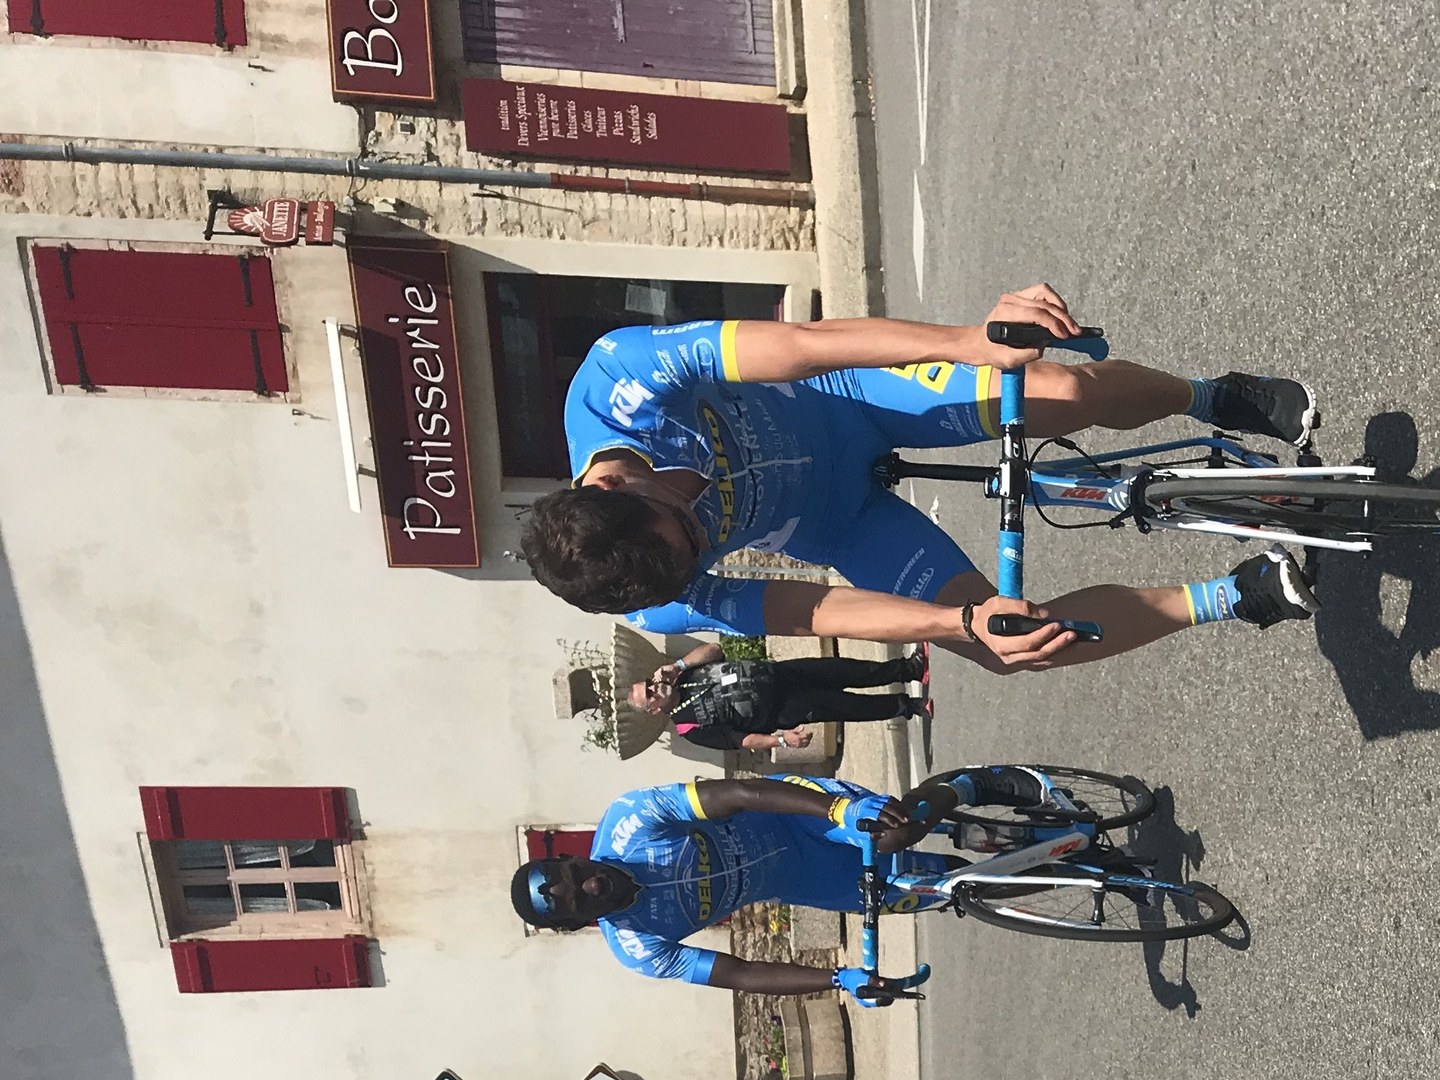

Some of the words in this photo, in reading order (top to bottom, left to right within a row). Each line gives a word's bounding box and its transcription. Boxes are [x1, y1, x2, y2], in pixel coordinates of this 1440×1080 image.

[498, 100, 510, 130] tradition
[535, 92, 549, 141] Viennoiseries
[552, 123, 564, 138] pure
[580, 110, 593, 132] Glaces
[596, 106, 608, 138] Traiteur
[612, 110, 624, 136] Pizzas
[627, 104, 642, 145] Sandwichs
[645, 112, 658, 140] Salades
[517, 121, 530, 146] Divers
[272, 202, 290, 237] JANETTE
[388, 282, 462, 540] Patisserie
[702, 407, 734, 542] DELKO
[610, 812, 644, 856] KTM
[694, 832, 712, 920] DELKO
[614, 918, 652, 960] KTM
